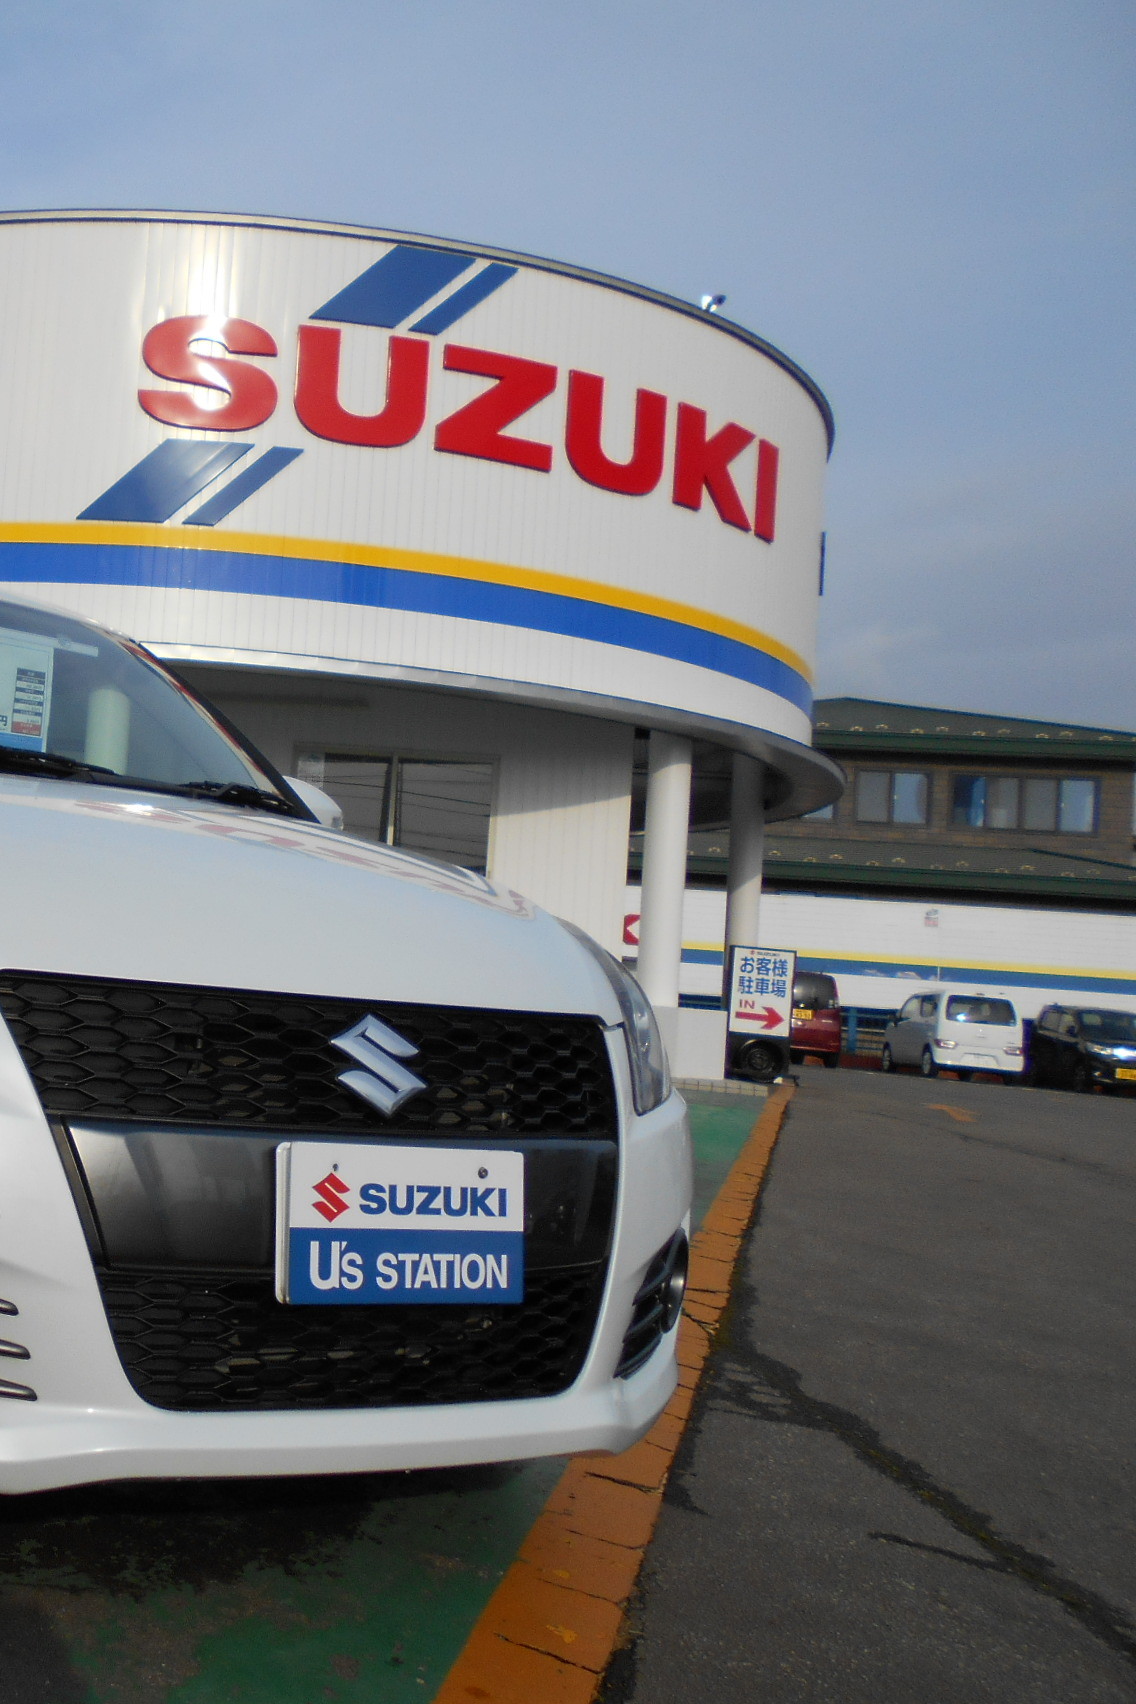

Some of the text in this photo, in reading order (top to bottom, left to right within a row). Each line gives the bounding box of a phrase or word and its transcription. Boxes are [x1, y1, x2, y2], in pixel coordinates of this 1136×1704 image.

[137, 314, 779, 543] SUZUKI
[739, 956, 788, 978] お客様
[738, 976, 787, 998] 駐車場
[739, 999, 755, 1009] IN
[358, 1182, 508, 1218] SUZUKI
[375, 1252, 509, 1290] STATION
